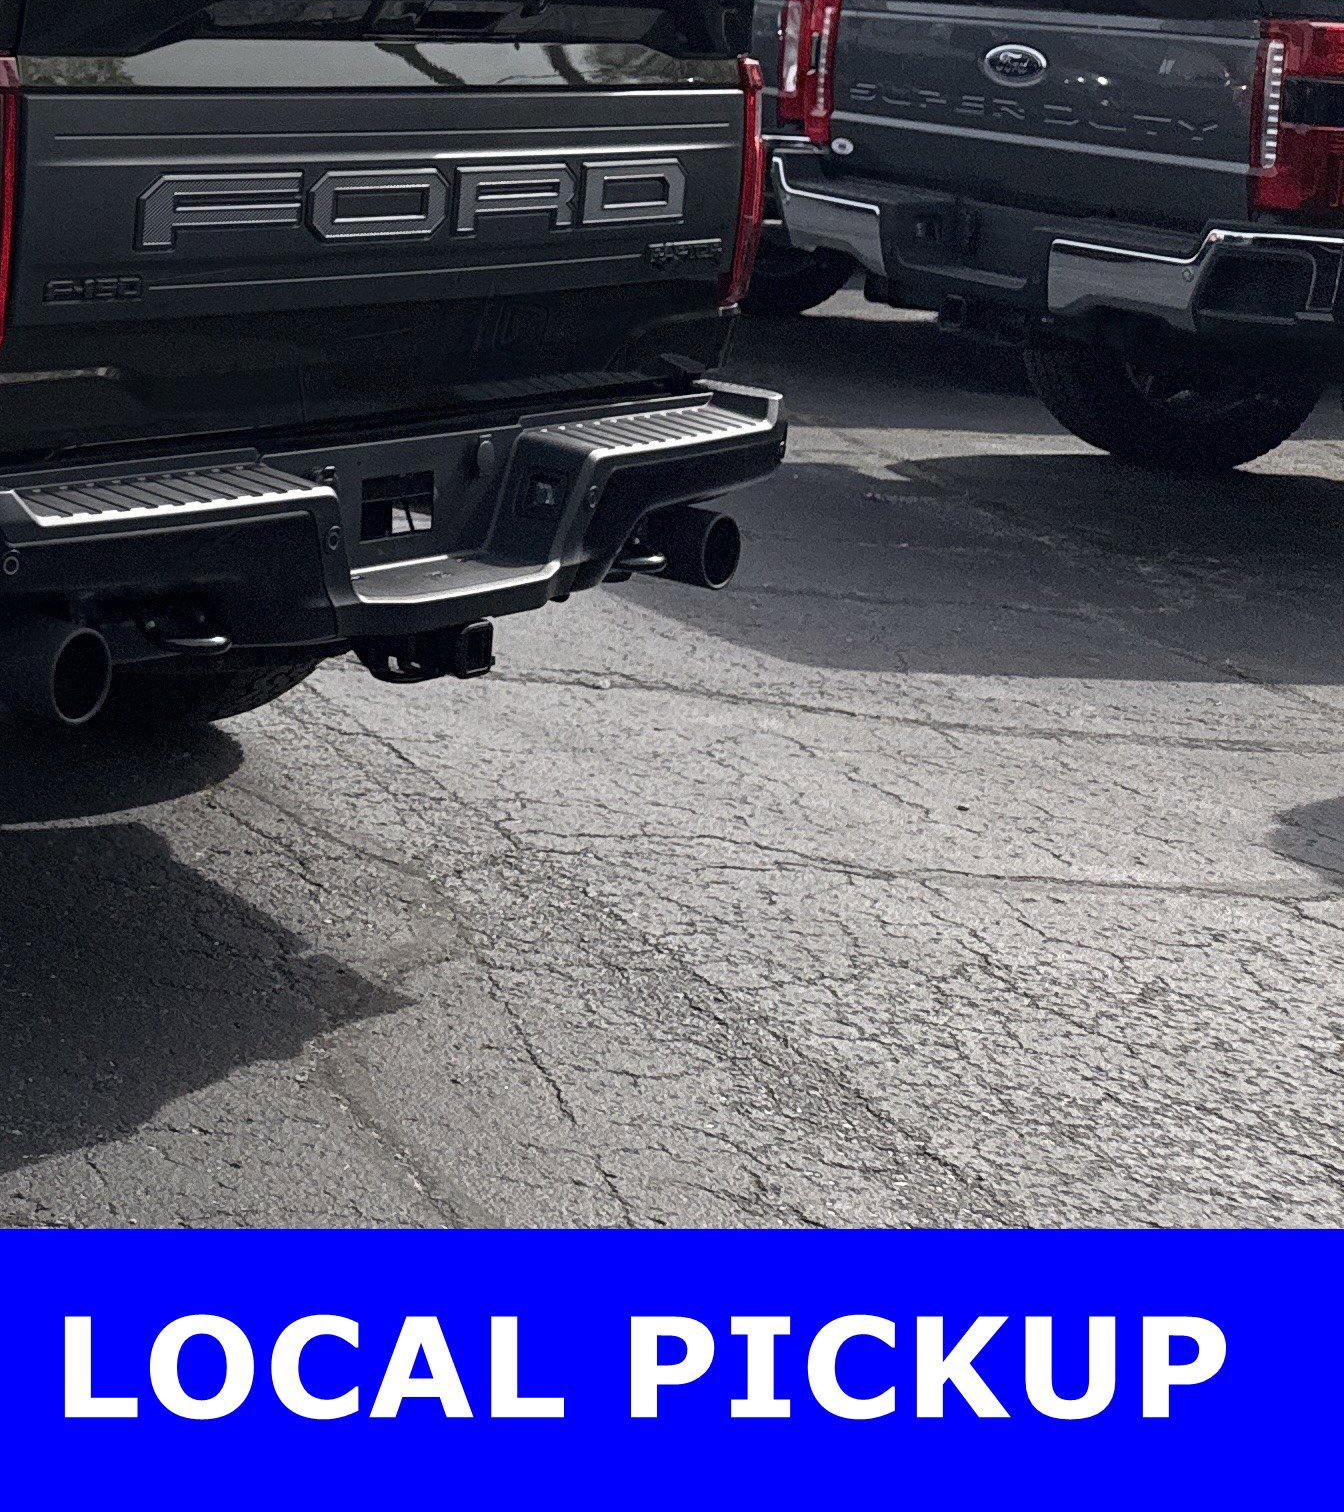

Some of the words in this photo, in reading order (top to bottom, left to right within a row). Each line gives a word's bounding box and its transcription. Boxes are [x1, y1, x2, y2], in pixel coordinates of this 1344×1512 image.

[849, 82, 1026, 121] SUPER
[1043, 102, 1218, 142] DUTY
[134, 157, 687, 250] FORD
